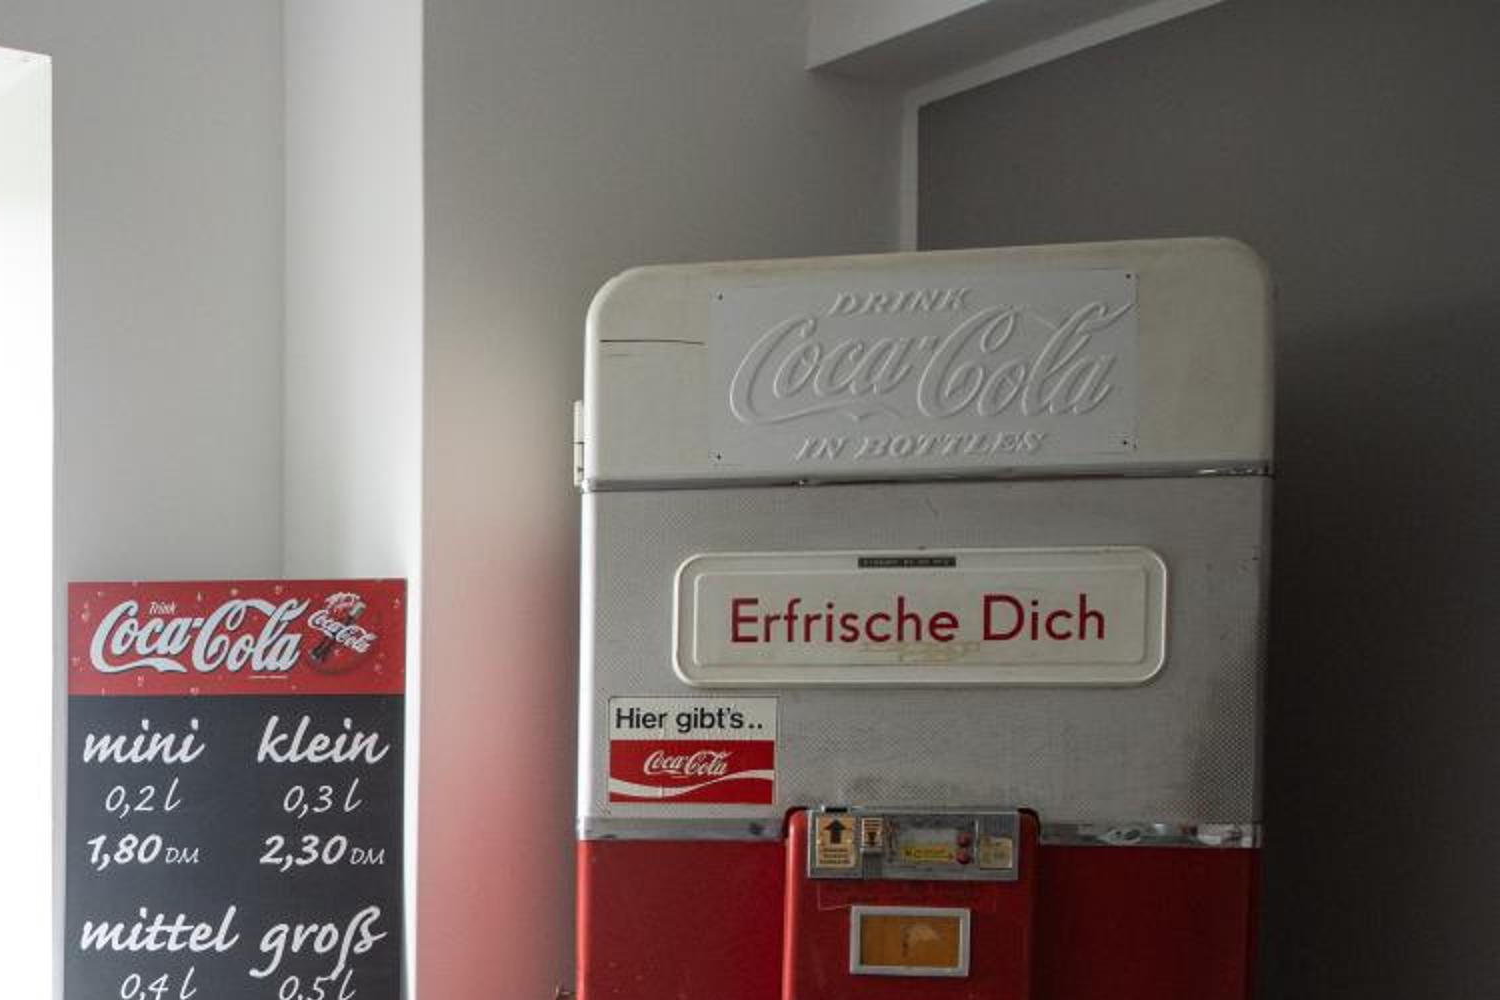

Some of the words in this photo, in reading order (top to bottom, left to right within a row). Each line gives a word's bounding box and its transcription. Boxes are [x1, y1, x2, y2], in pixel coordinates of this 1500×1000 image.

[828, 288, 972, 317] DRINK
[729, 303, 1133, 427] Coca-Cola
[797, 433, 846, 462] IN
[855, 431, 1048, 461] BOTTLES
[90, 598, 311, 674] Coca-Cola
[307, 609, 378, 654] Coca-Cola
[730, 595, 960, 644] Erfrische
[982, 593, 1107, 642] Dich
[257, 715, 390, 764] klein
[615, 707, 667, 730] Hier
[83, 719, 206, 764] mini
[643, 750, 734, 777] Coca-Cola
[105, 785, 156, 818] 0,2
[164, 777, 181, 812] l
[283, 785, 333, 819] 0,3
[343, 777, 363, 812] l
[87, 834, 163, 872] 1,80
[165, 847, 200, 864] DM
[259, 834, 348, 872] 2,30
[350, 848, 385, 865] DM
[80, 905, 240, 952] mittel
[249, 905, 388, 980] groß
[180, 966, 197, 1000] l
